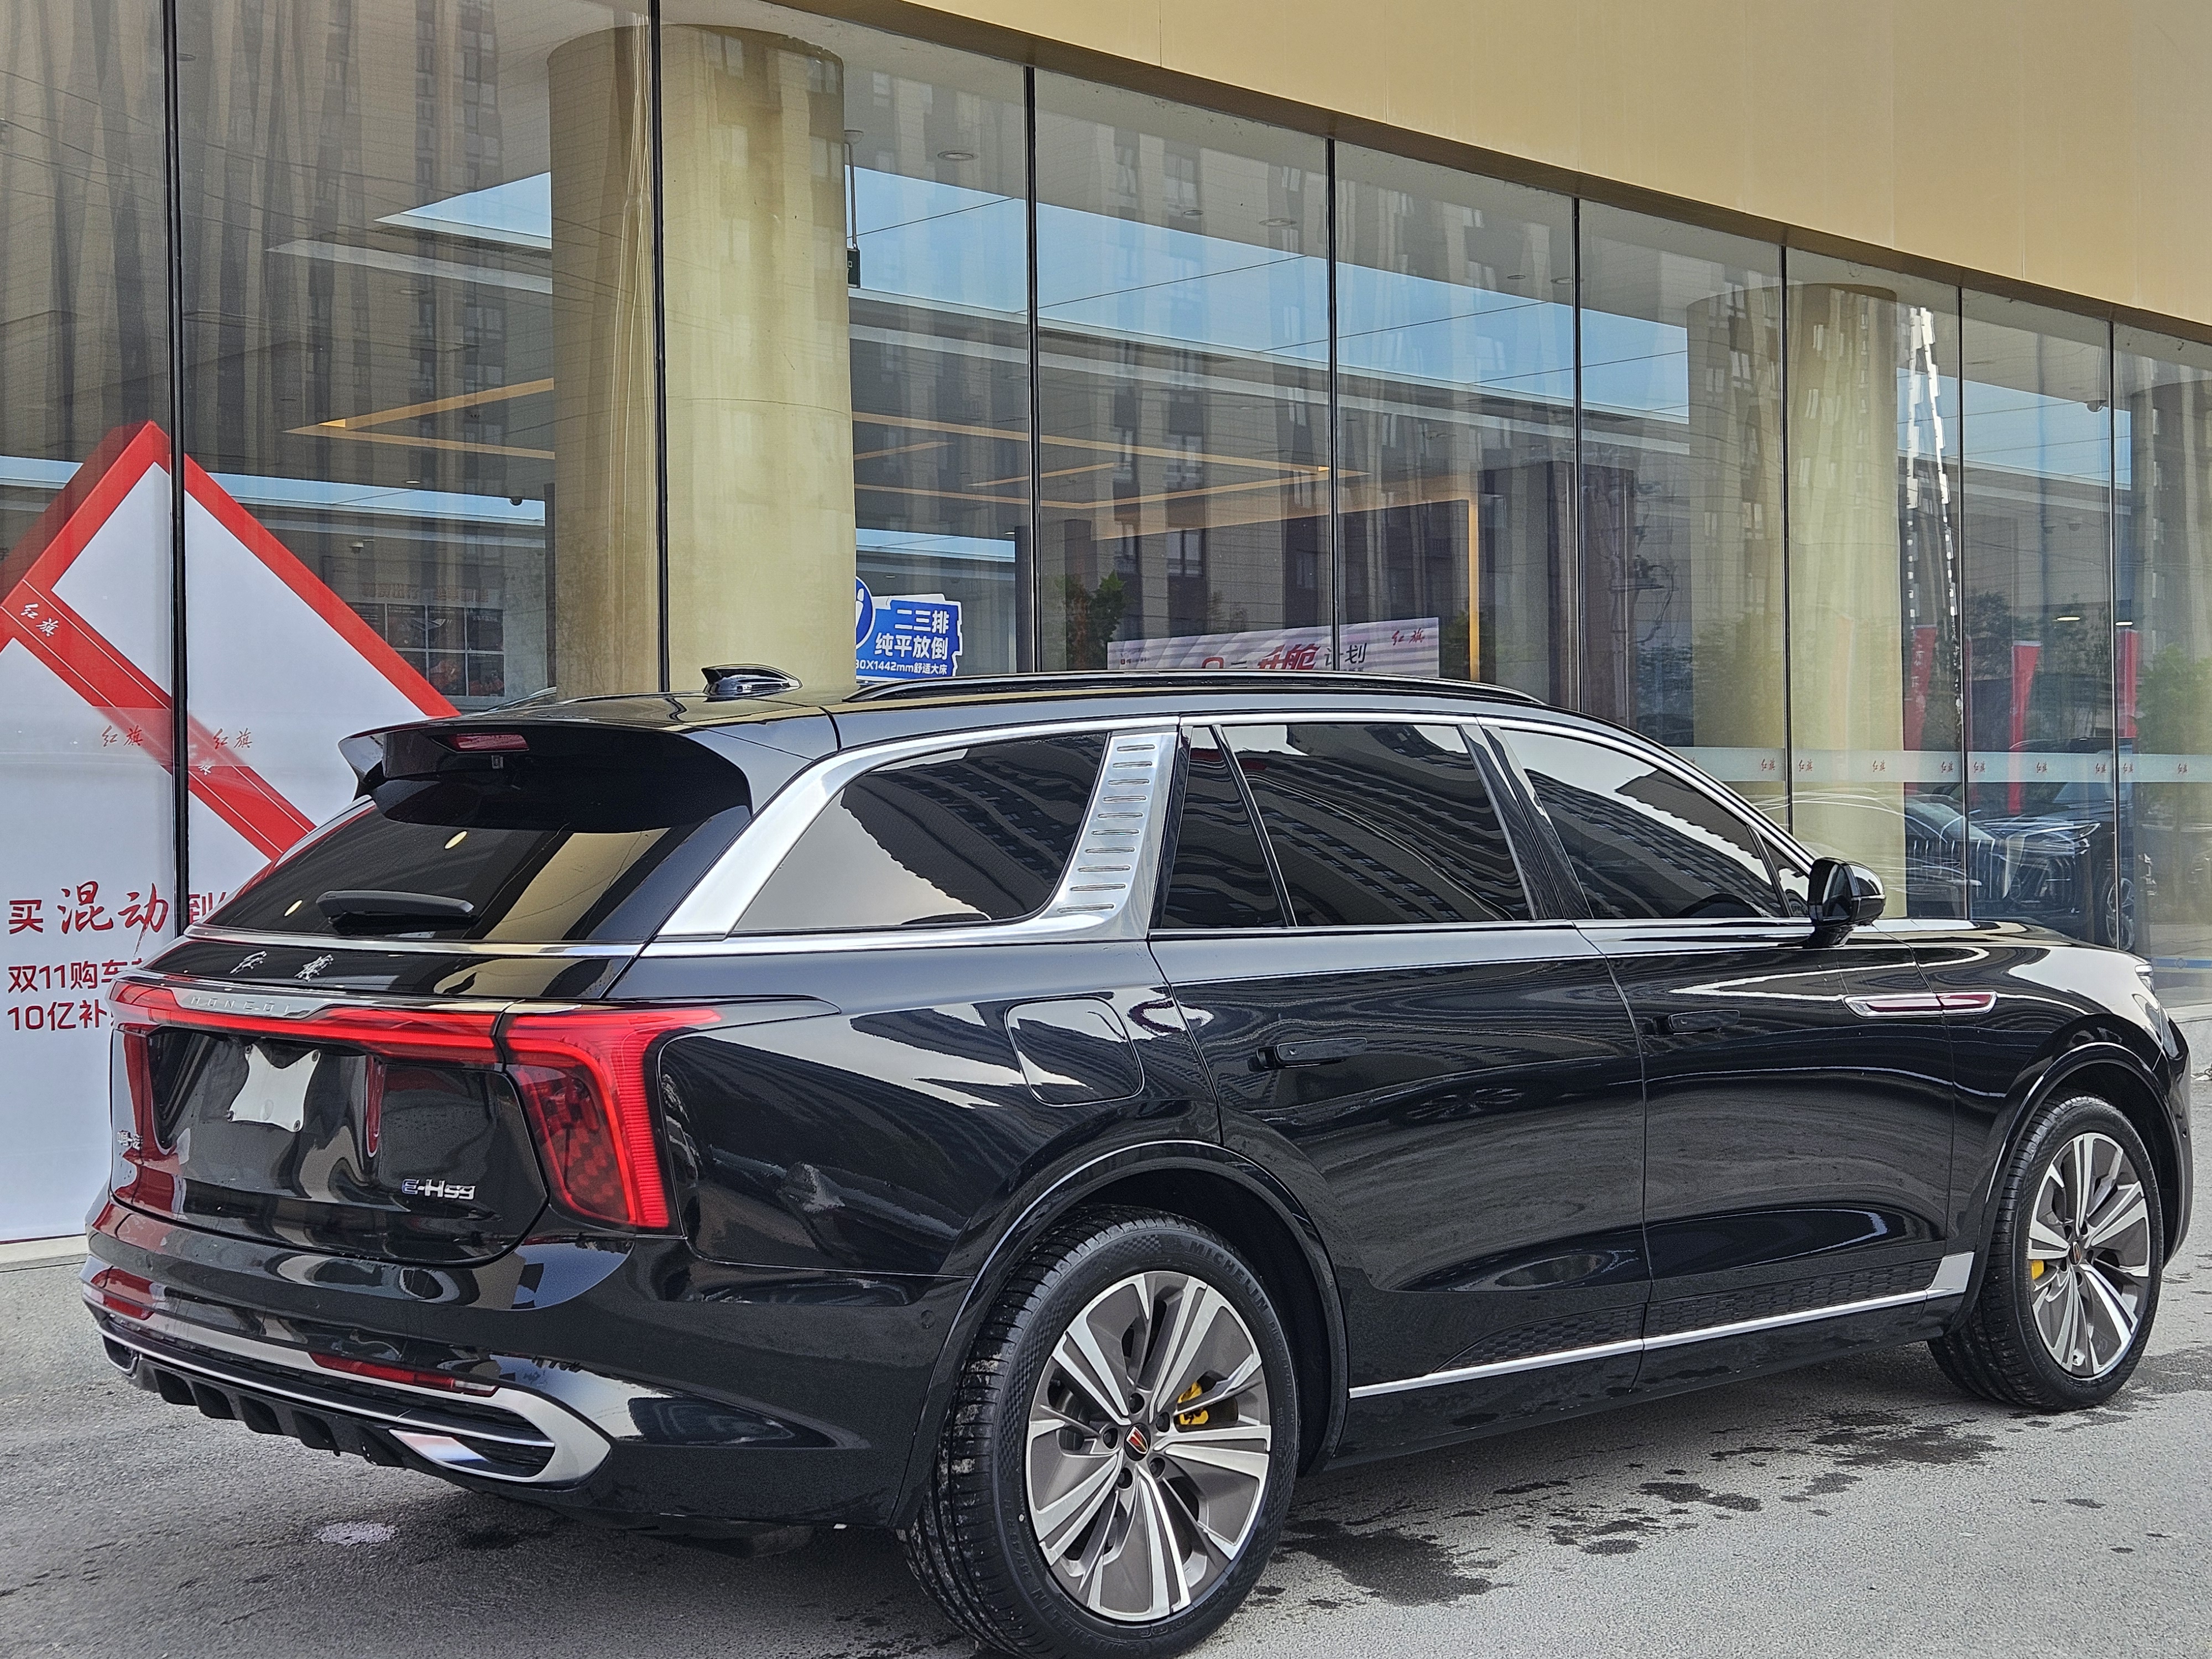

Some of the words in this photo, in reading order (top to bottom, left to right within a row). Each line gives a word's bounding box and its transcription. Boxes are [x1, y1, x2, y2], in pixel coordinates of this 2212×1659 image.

[20, 603, 59, 637] 红旗
[894, 609, 950, 634] 二三排
[874, 632, 948, 660] 纯平放倒
[1391, 628, 1425, 646] 红旗
[102, 725, 143, 747] 红旗
[213, 728, 252, 749] 红旗
[8, 958, 142, 994] 双11购车
[7, 999, 114, 1031] 10亿补
[1190, 1241, 1269, 1313] MICHELIN
